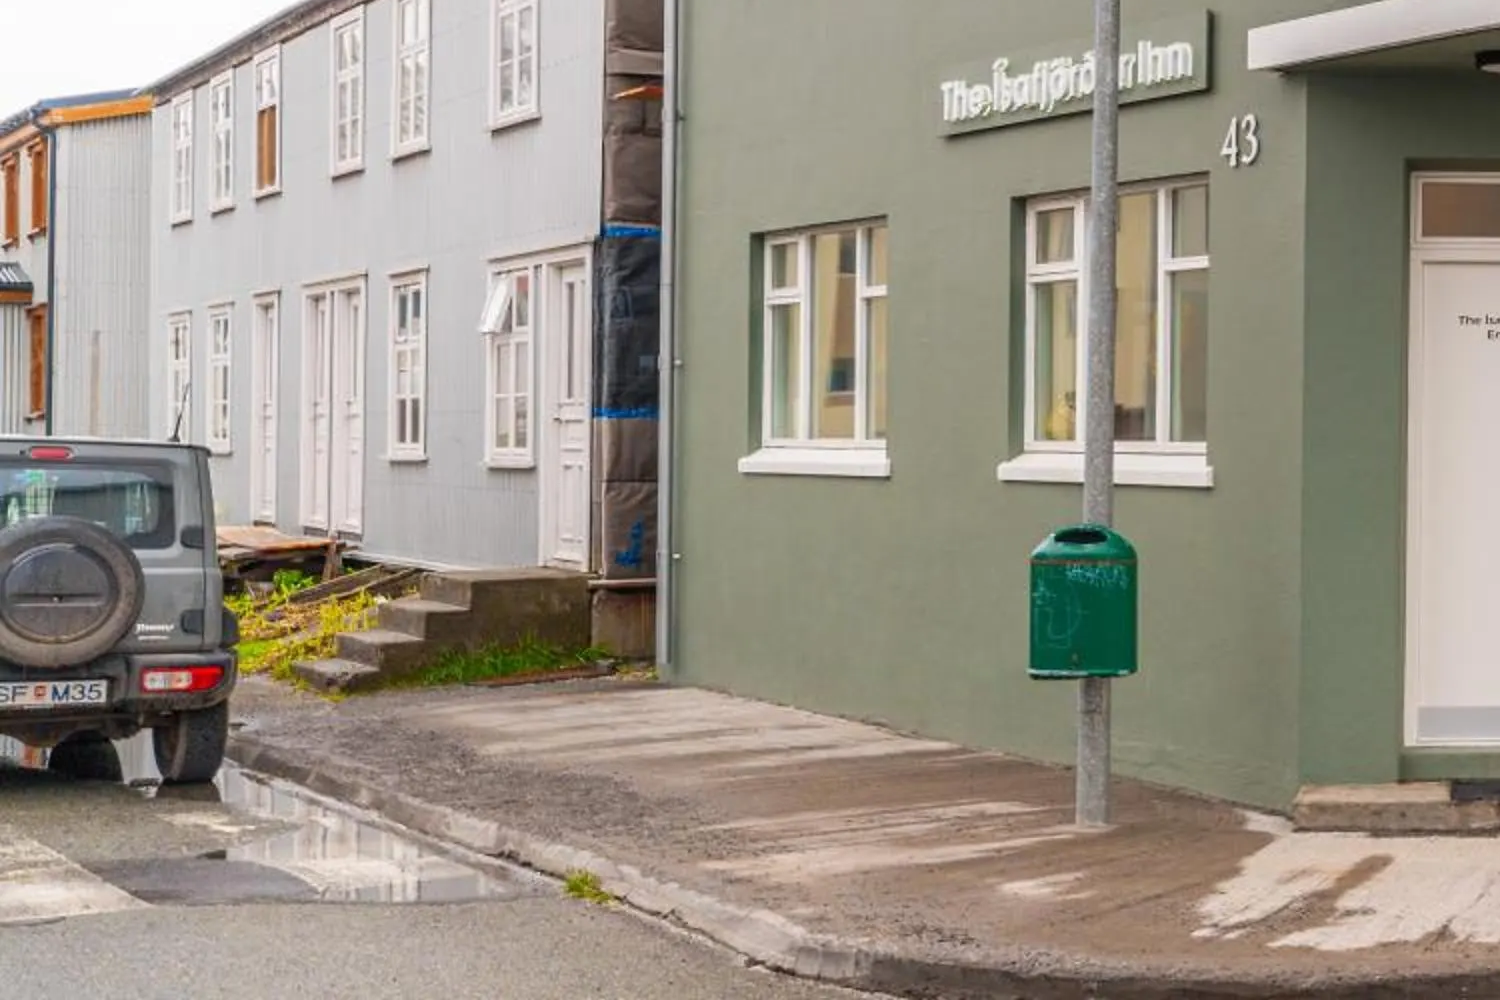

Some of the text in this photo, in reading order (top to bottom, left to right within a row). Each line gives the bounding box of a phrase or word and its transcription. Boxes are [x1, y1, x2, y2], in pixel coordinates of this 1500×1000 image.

[940, 39, 1193, 121] The Ísafjörðr Inn
[1220, 113, 1260, 168] 43
[1458, 315, 1481, 326] The
[52, 684, 102, 702] M35
